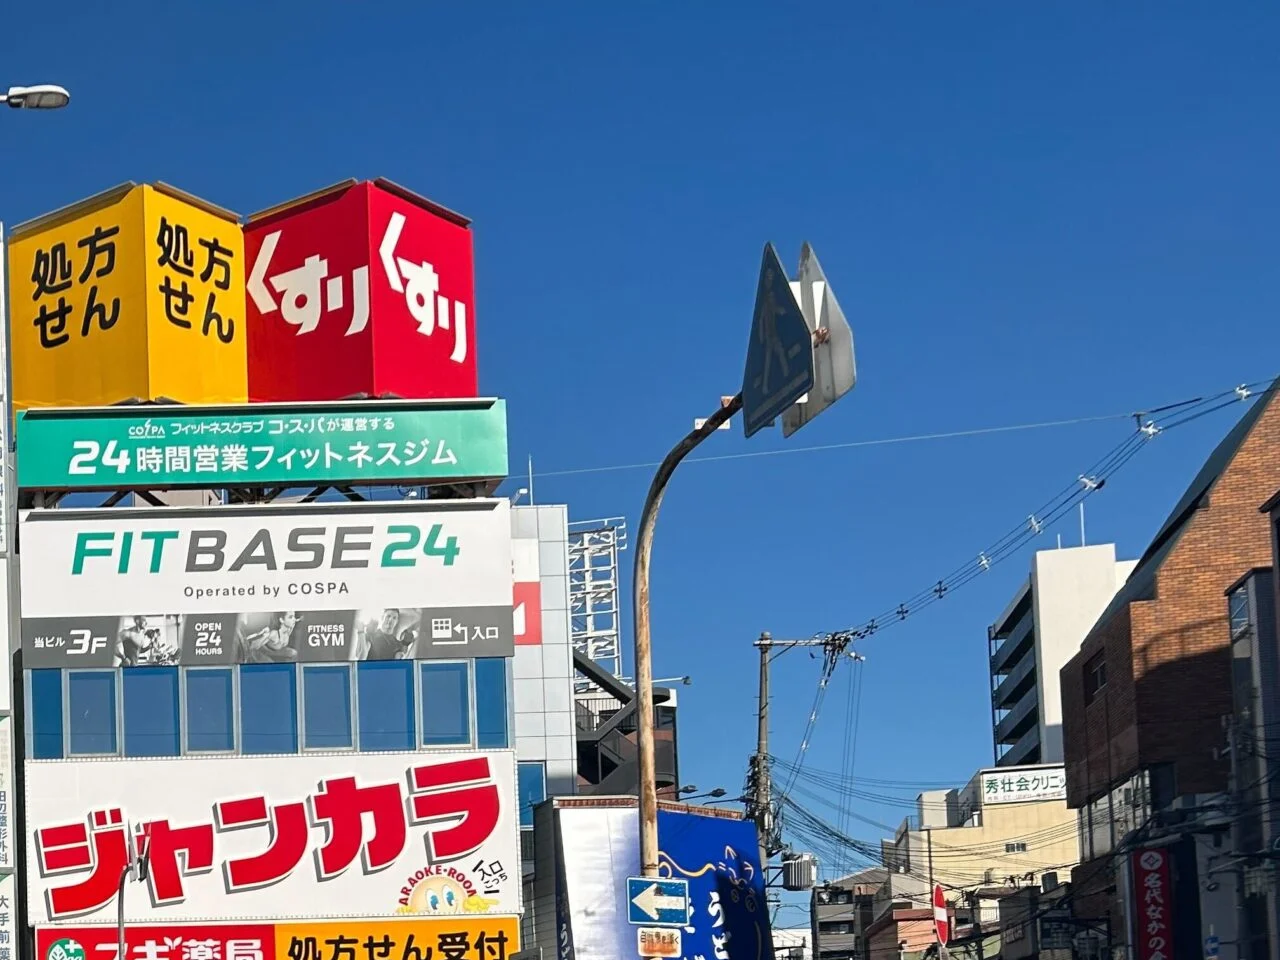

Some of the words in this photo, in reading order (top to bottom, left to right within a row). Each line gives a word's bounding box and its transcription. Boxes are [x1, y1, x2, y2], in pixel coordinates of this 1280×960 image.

[156, 215, 236, 292] 処方
[30, 225, 121, 302] 処方
[246, 231, 371, 337] くすり
[379, 211, 468, 364] くすり
[32, 286, 121, 349] せん
[157, 274, 236, 344] せん
[170, 420, 265, 435] フィットネスクラブ
[67, 438, 458, 477] 24時間営業フィットネスジム
[184, 584, 257, 600] Operated
[262, 584, 280, 599] by
[286, 582, 350, 596] COSPA
[195, 622, 222, 632] OPEN
[307, 623, 345, 634] FITNESS
[471, 626, 499, 641] 入口
[34, 636, 65, 649] 当ビル
[66, 629, 108, 655] 3F
[195, 631, 222, 647] 24
[308, 633, 345, 647] GYM
[195, 648, 223, 656] HOURS
[985, 776, 1067, 795] 秀壮会クリニッ
[34, 756, 501, 921] ジャンカラ
[483, 872, 509, 889] こっち
